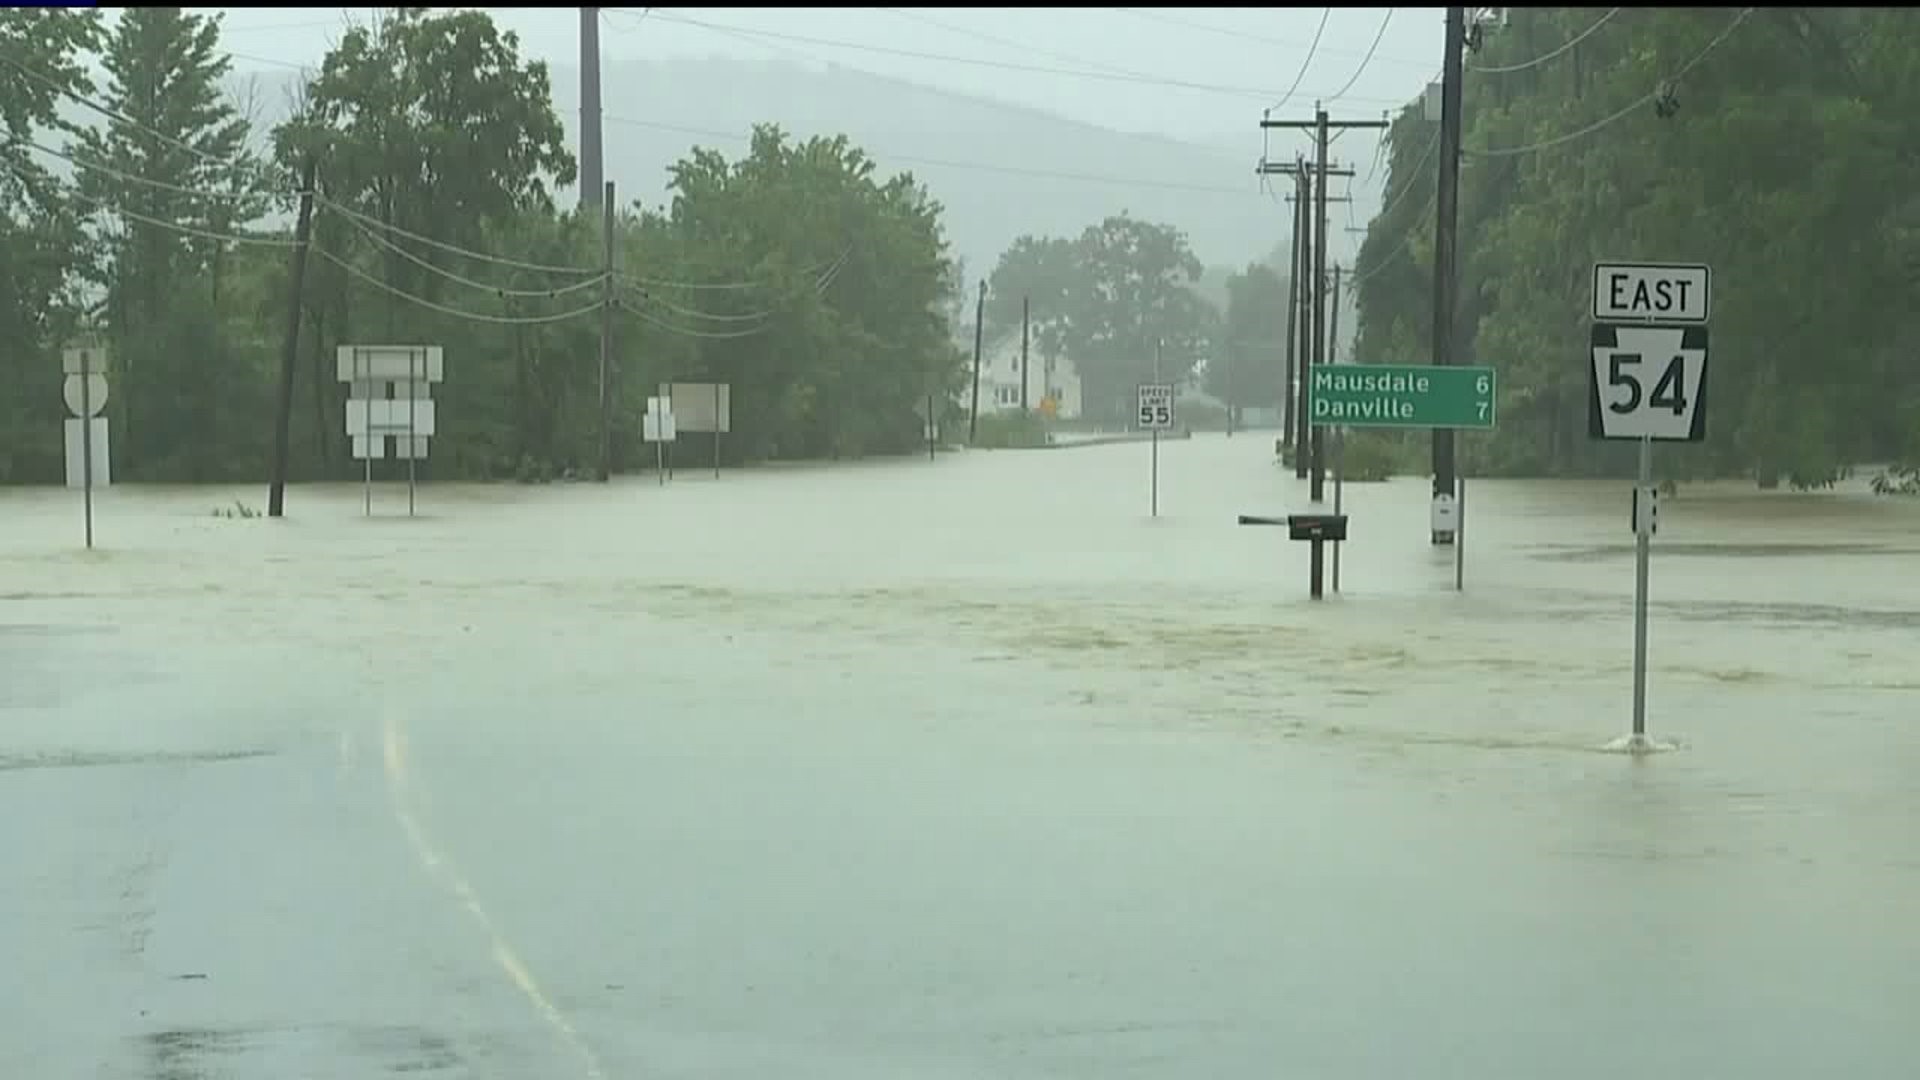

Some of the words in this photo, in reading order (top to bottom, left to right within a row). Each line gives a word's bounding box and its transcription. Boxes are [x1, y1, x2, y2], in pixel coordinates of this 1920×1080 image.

[1610, 274, 1692, 312] EAST
[1141, 389, 1170, 397] SPEED
[1315, 371, 1430, 392] Mausdale
[1475, 375, 1489, 394] 6
[1609, 353, 1687, 416] 54
[1143, 398, 1166, 406] LIMIT
[1315, 397, 1414, 418] Danville
[1475, 402, 1489, 420] 7
[1141, 407, 1169, 424] 55
